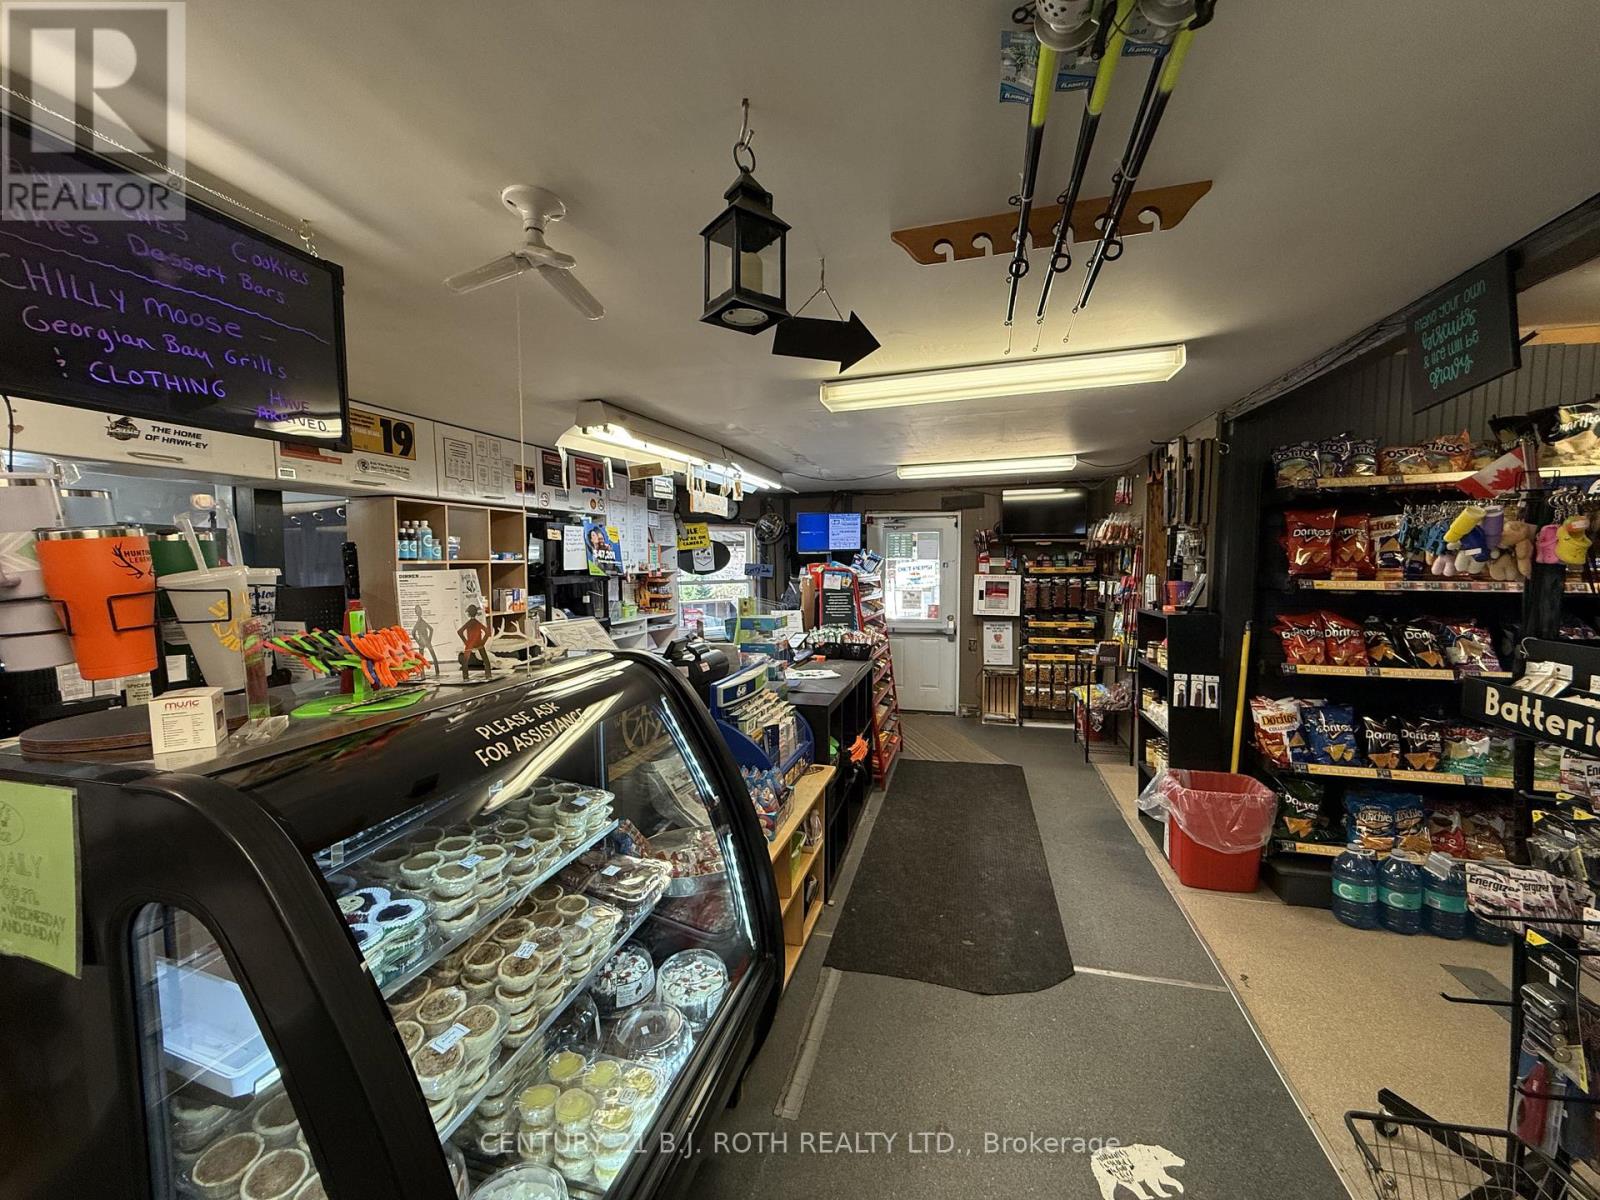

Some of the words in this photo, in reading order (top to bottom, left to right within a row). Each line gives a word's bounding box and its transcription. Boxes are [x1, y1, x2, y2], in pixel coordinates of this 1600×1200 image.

[128, 233, 226, 284] Dessert
[242, 273, 285, 305] Bars
[232, 241, 309, 286] Cookies
[1438, 293, 1461, 319] your
[1463, 279, 1486, 302] own
[22, 305, 156, 353] Georgian
[163, 334, 214, 369] Bay
[224, 352, 288, 380] Grills
[1421, 308, 1478, 351] biscuits
[1447, 337, 1464, 356] will
[1465, 329, 1479, 349] be
[89, 360, 227, 399] CLOTHING
[1429, 353, 1474, 390] gravy
[144, 433, 160, 442] OF
[151, 425, 171, 434] THE
[173, 429, 203, 440] HOME
[380, 418, 412, 456] 19
[1293, 527, 1332, 537] Doritos
[1325, 628, 1361, 639] Doritos
[164, 699, 201, 711] music
[1261, 713, 1298, 728] Doritos
[474, 741, 512, 768] FOR
[512, 707, 584, 752] ASSISTANCE
[475, 710, 533, 741] PLEASE
[535, 702, 561, 720] ASK
[1365, 729, 1399, 741] Dorito
[1468, 873, 1521, 893] Energizer
[1519, 881, 1550, 894] nergizer
